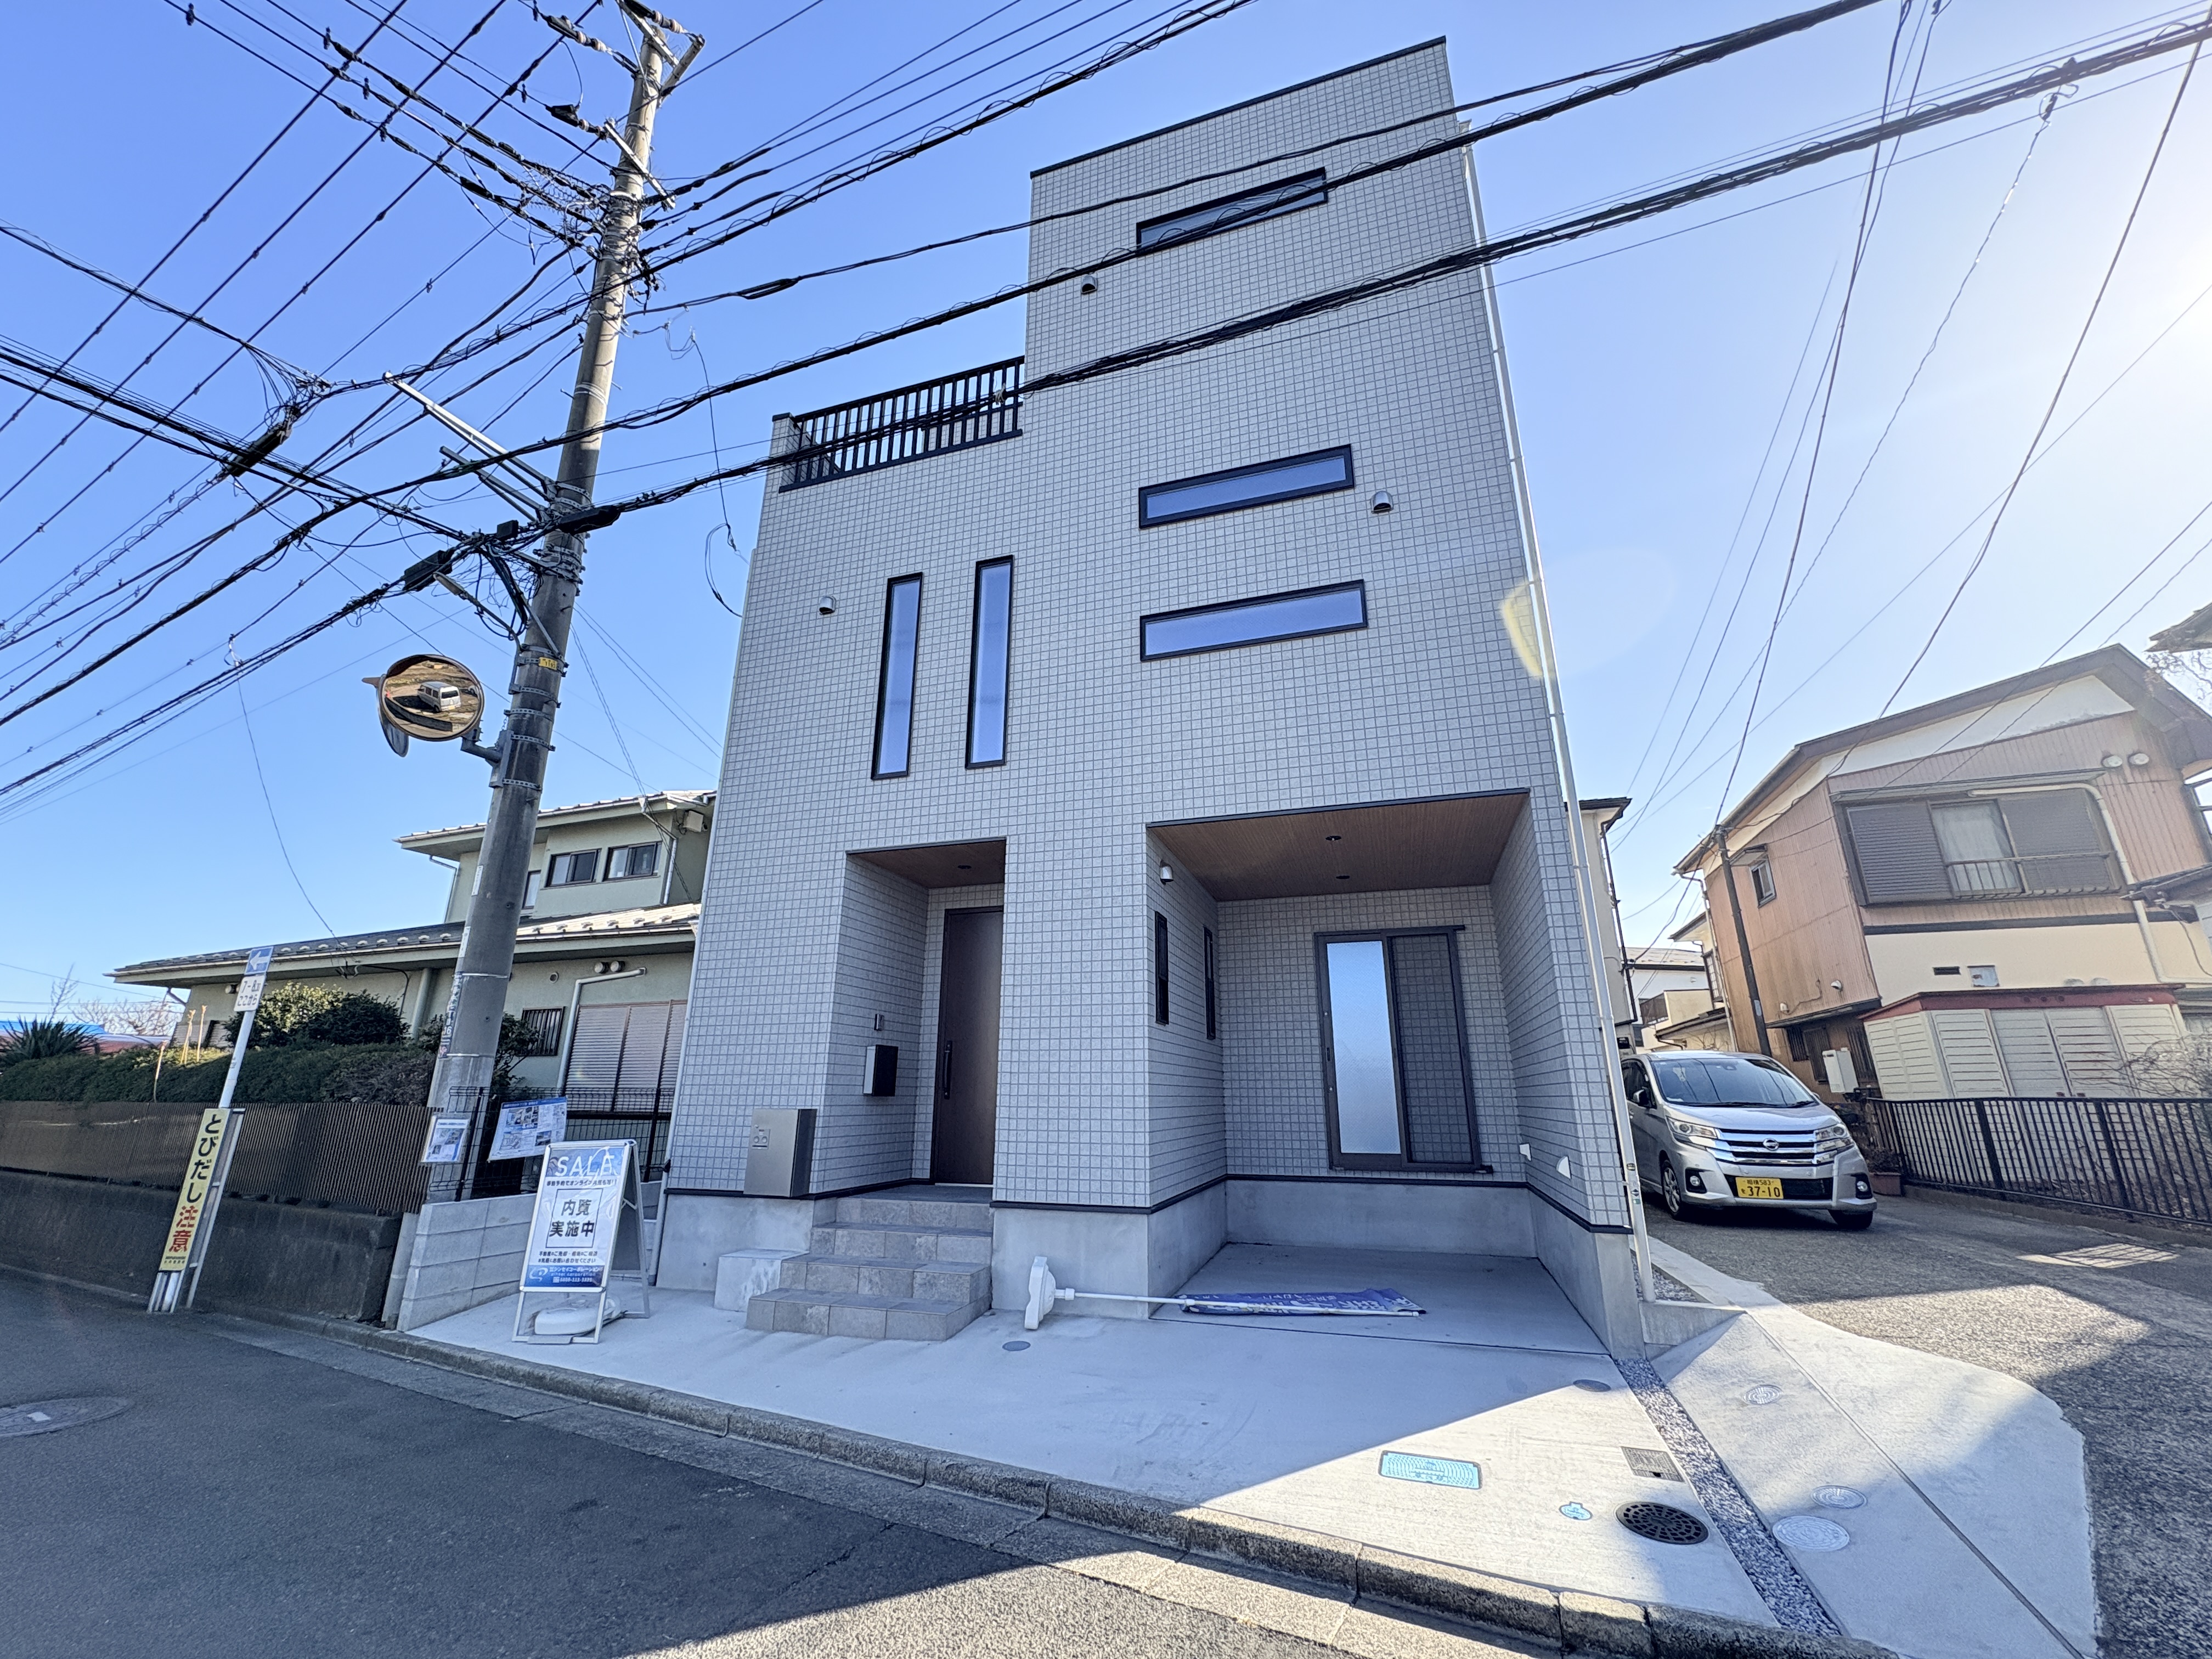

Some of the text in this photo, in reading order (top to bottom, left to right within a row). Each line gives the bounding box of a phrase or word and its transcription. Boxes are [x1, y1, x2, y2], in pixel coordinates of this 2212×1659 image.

[237, 994, 258, 1006] ここから
[168, 1114, 221, 1252] とびだし注意
[1747, 1186, 1781, 1197] 37-10
[561, 1199, 592, 1216] 内覧
[549, 1220, 595, 1238] 実施中
